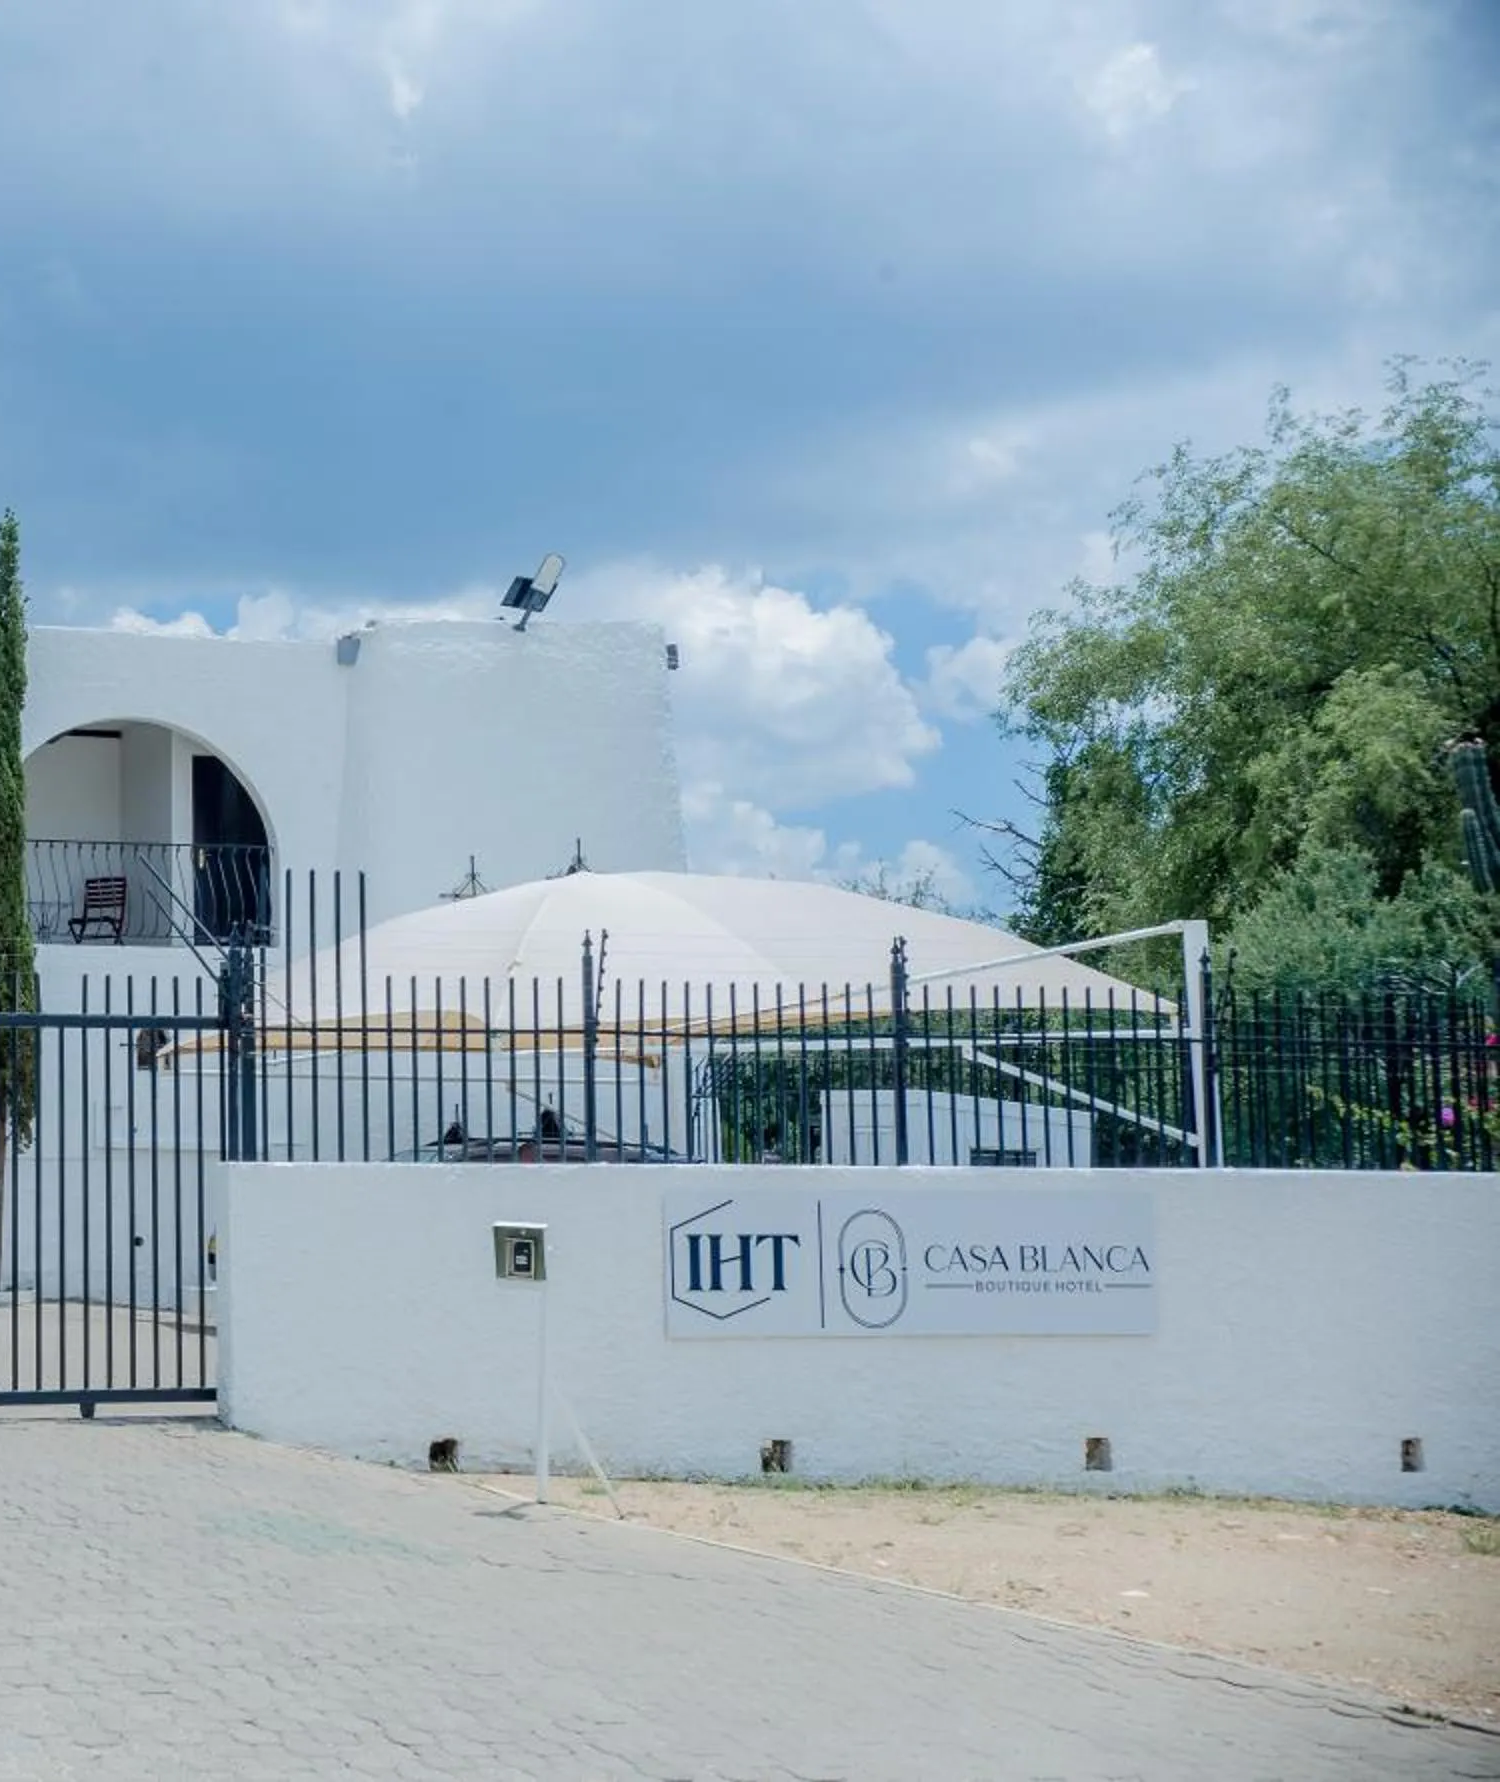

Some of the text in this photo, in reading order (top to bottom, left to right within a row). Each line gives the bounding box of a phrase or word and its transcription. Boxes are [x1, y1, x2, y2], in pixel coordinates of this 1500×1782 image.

[686, 1234, 801, 1291] IHT
[924, 1245, 1150, 1273] CASA BLANCA
[975, 1280, 1103, 1292] BOUTIQUE HOTEL
